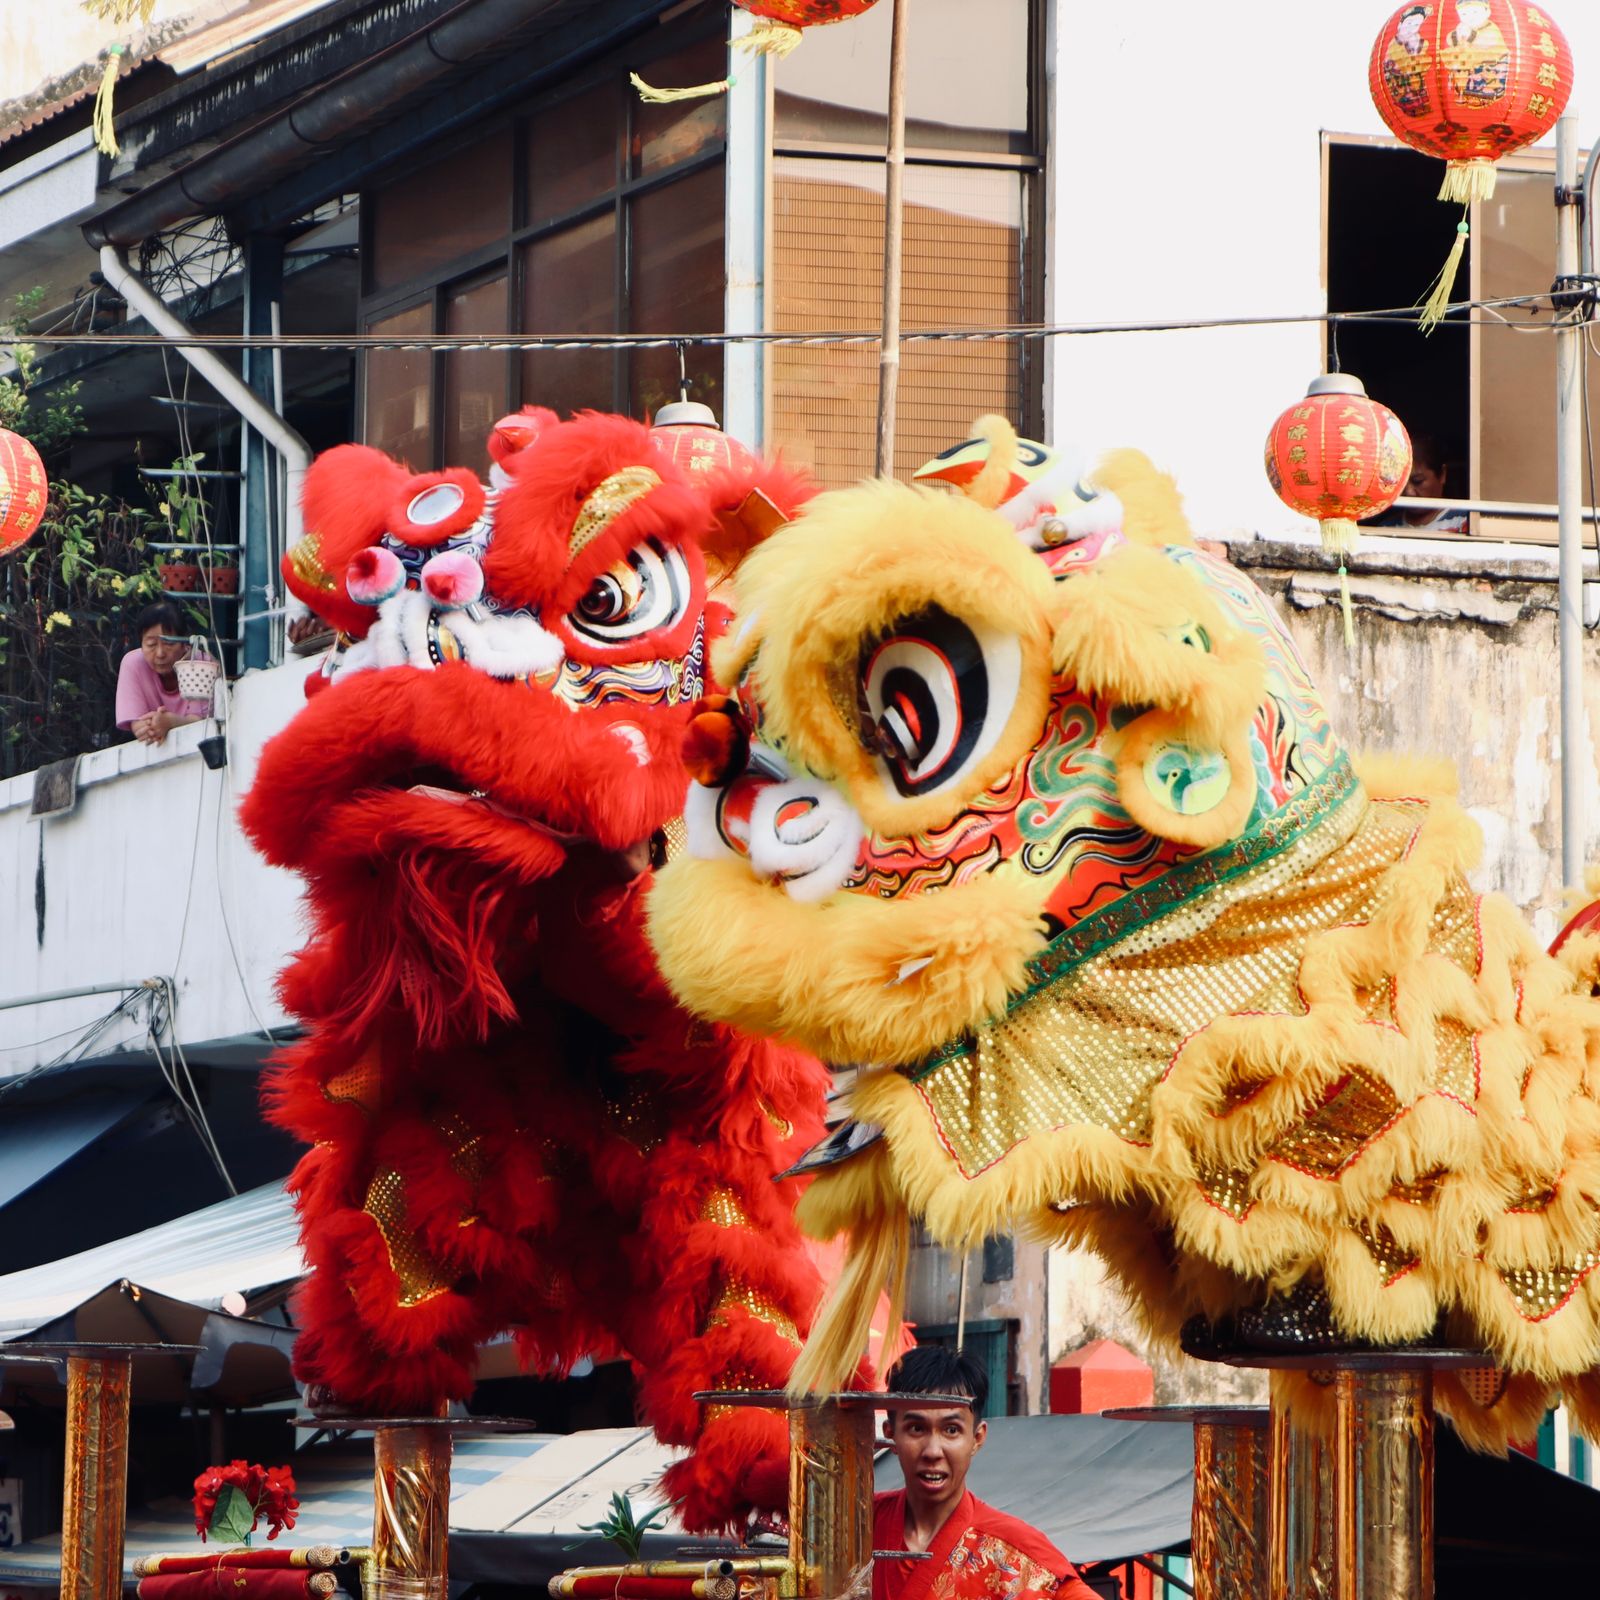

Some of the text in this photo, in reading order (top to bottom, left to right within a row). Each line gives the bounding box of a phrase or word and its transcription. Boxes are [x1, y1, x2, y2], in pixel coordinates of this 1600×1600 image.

[1287, 406, 1318, 486] 財源廣進
[1336, 405, 1366, 488] 大吉大利
